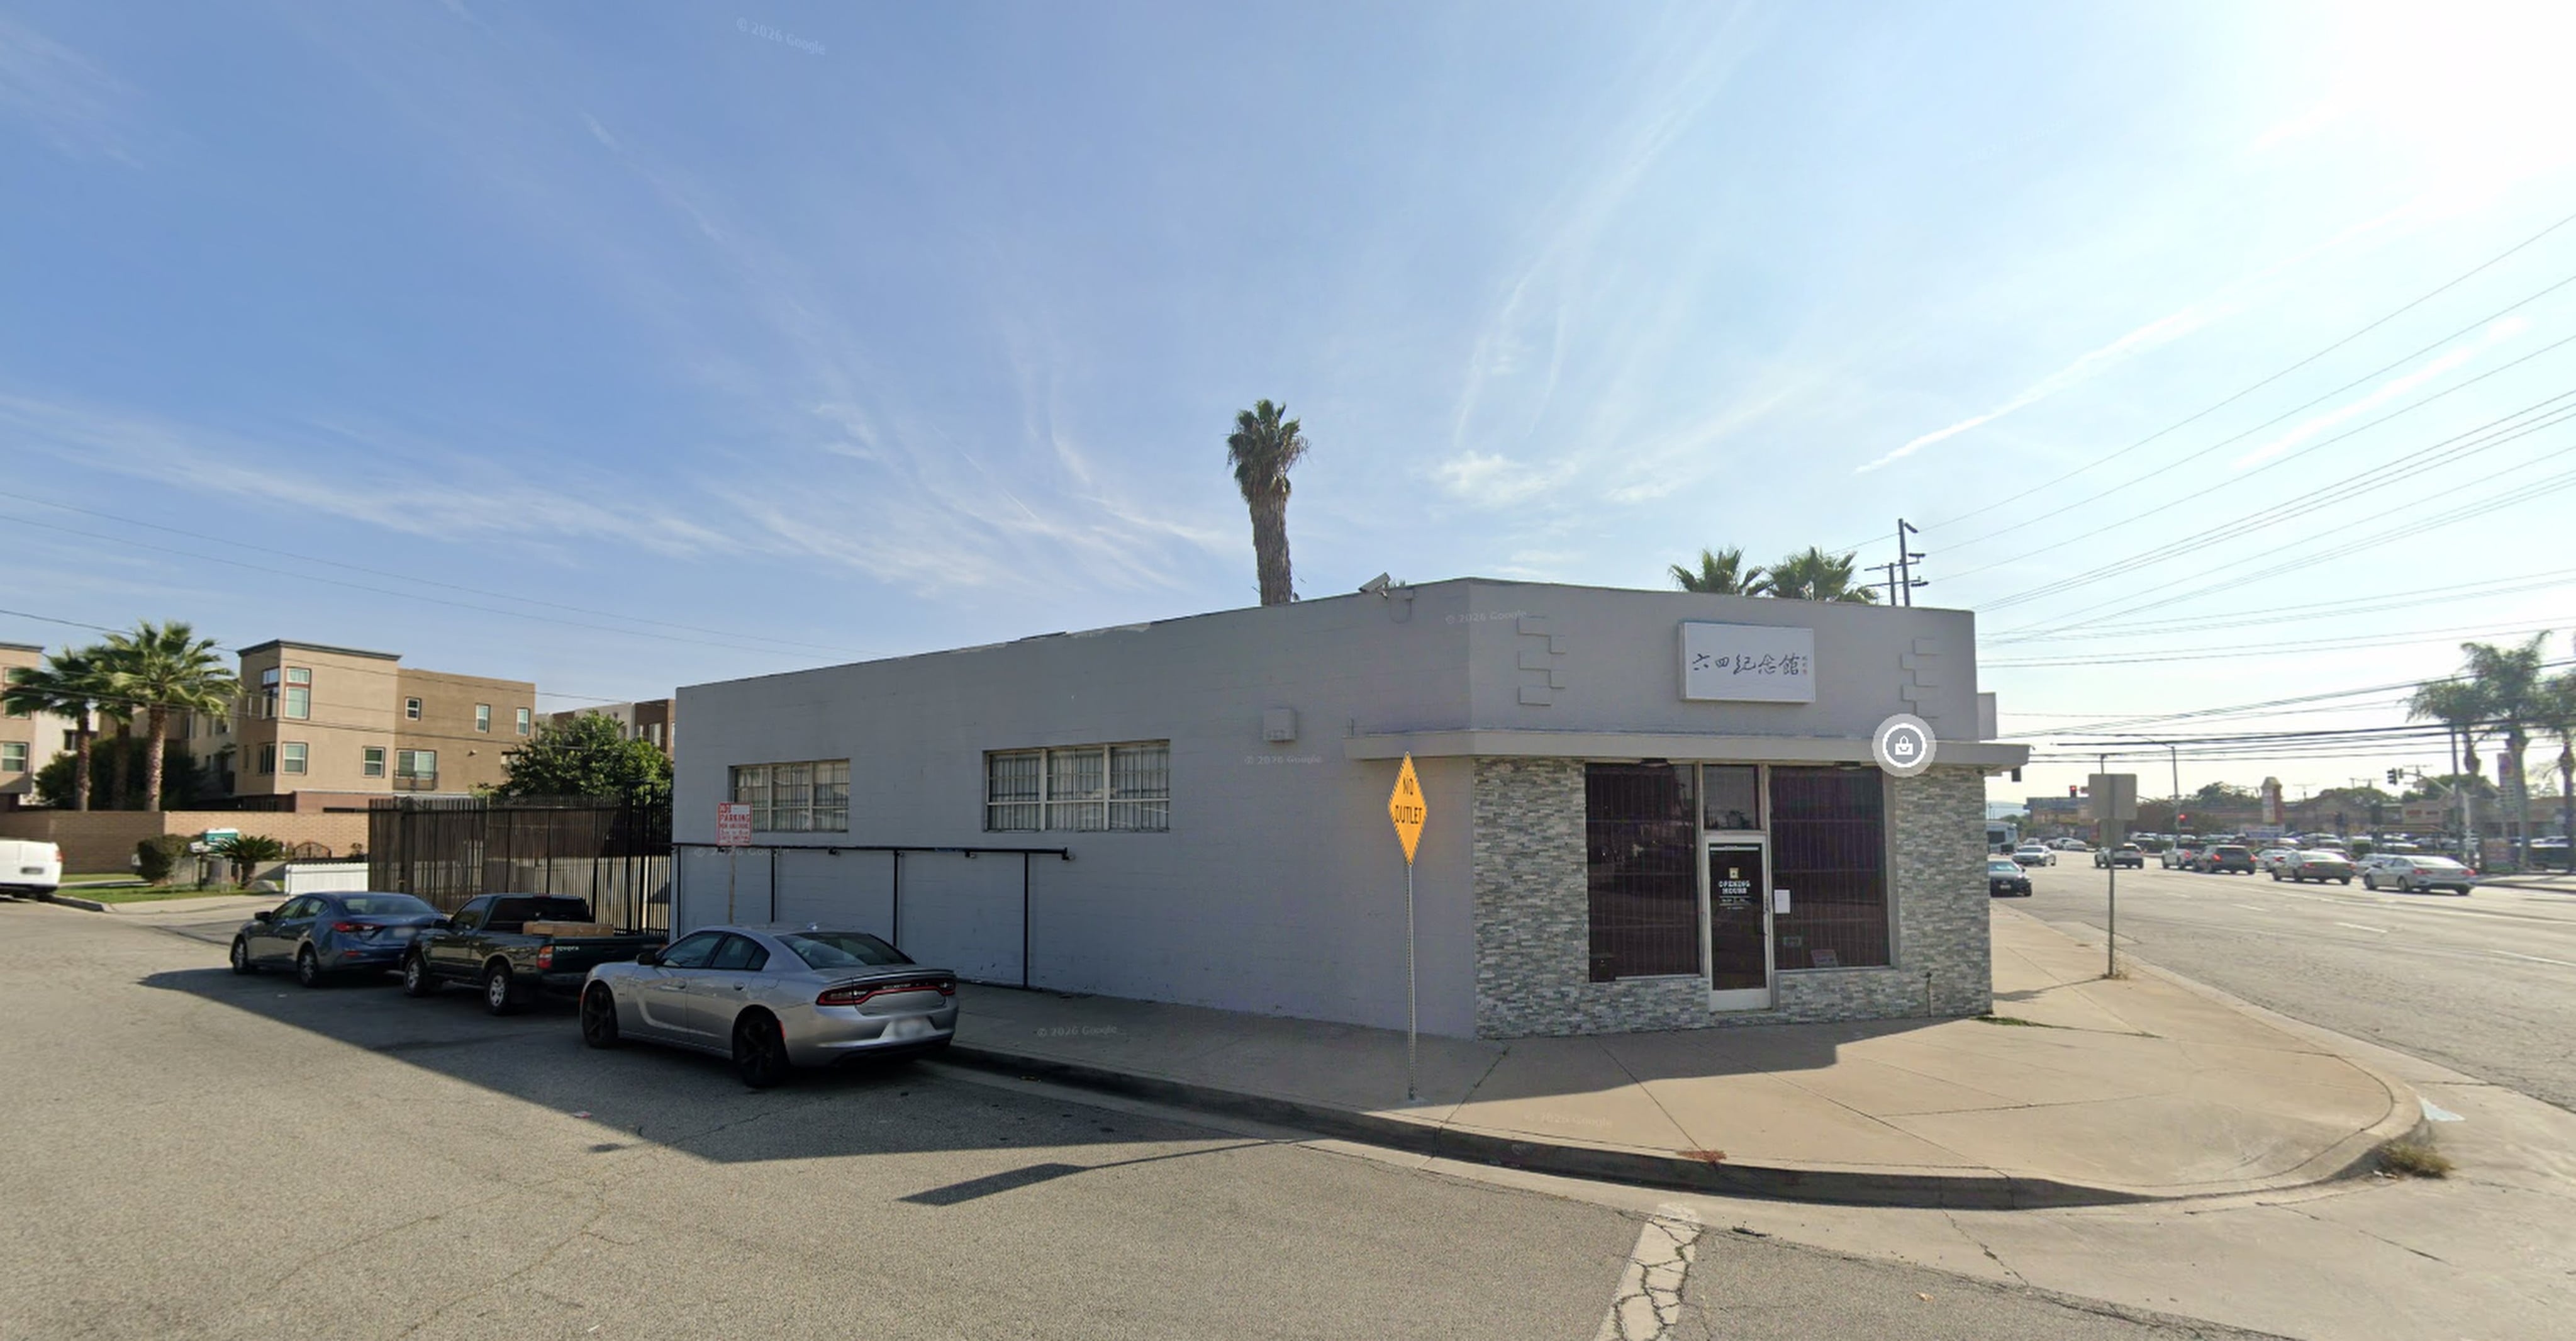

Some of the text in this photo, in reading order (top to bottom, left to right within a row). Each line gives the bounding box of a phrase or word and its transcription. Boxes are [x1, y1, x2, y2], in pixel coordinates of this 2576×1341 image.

[1403, 777, 1414, 795] NO
[720, 814, 750, 823] PARKING
[1395, 804, 1422, 824] OUTLET
